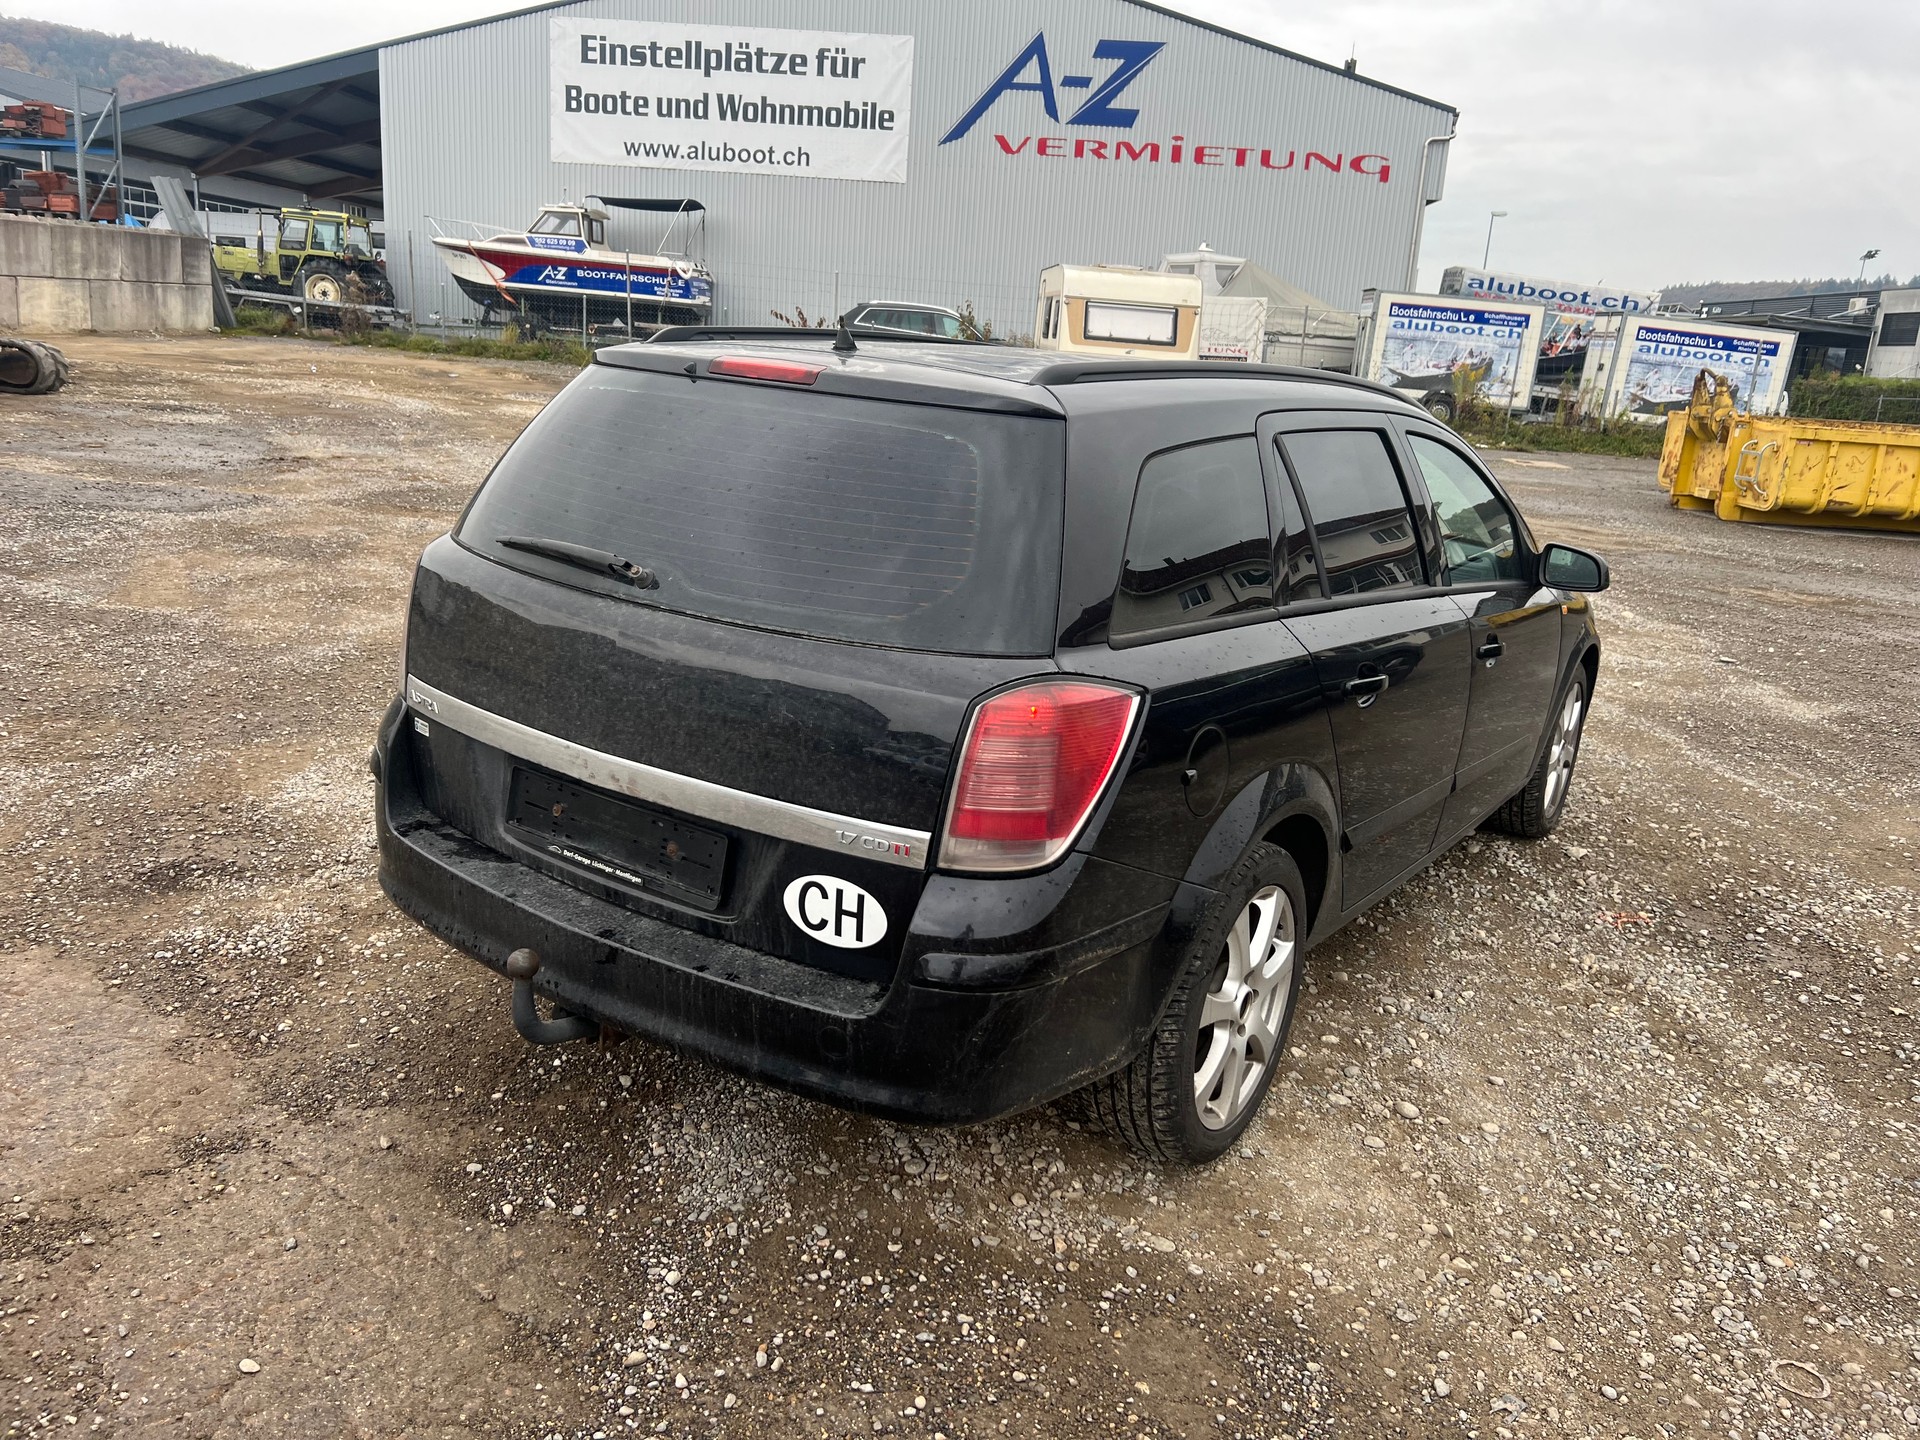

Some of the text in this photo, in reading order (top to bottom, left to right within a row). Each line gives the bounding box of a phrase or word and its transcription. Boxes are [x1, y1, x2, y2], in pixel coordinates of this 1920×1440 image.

[580, 34, 866, 79] Einstellplätze für
[937, 28, 1168, 146] A-Z
[564, 84, 895, 131] Boote und Wohnmobile
[623, 140, 811, 167] www.aluboot.ch
[537, 265, 568, 281] A-Z
[1467, 276, 1640, 311] aluboot.ch
[1392, 319, 1521, 340] aluboot.ch
[1638, 344, 1770, 368] aluboot.ch
[860, 835, 911, 858] CDTI
[798, 880, 866, 943] CH
